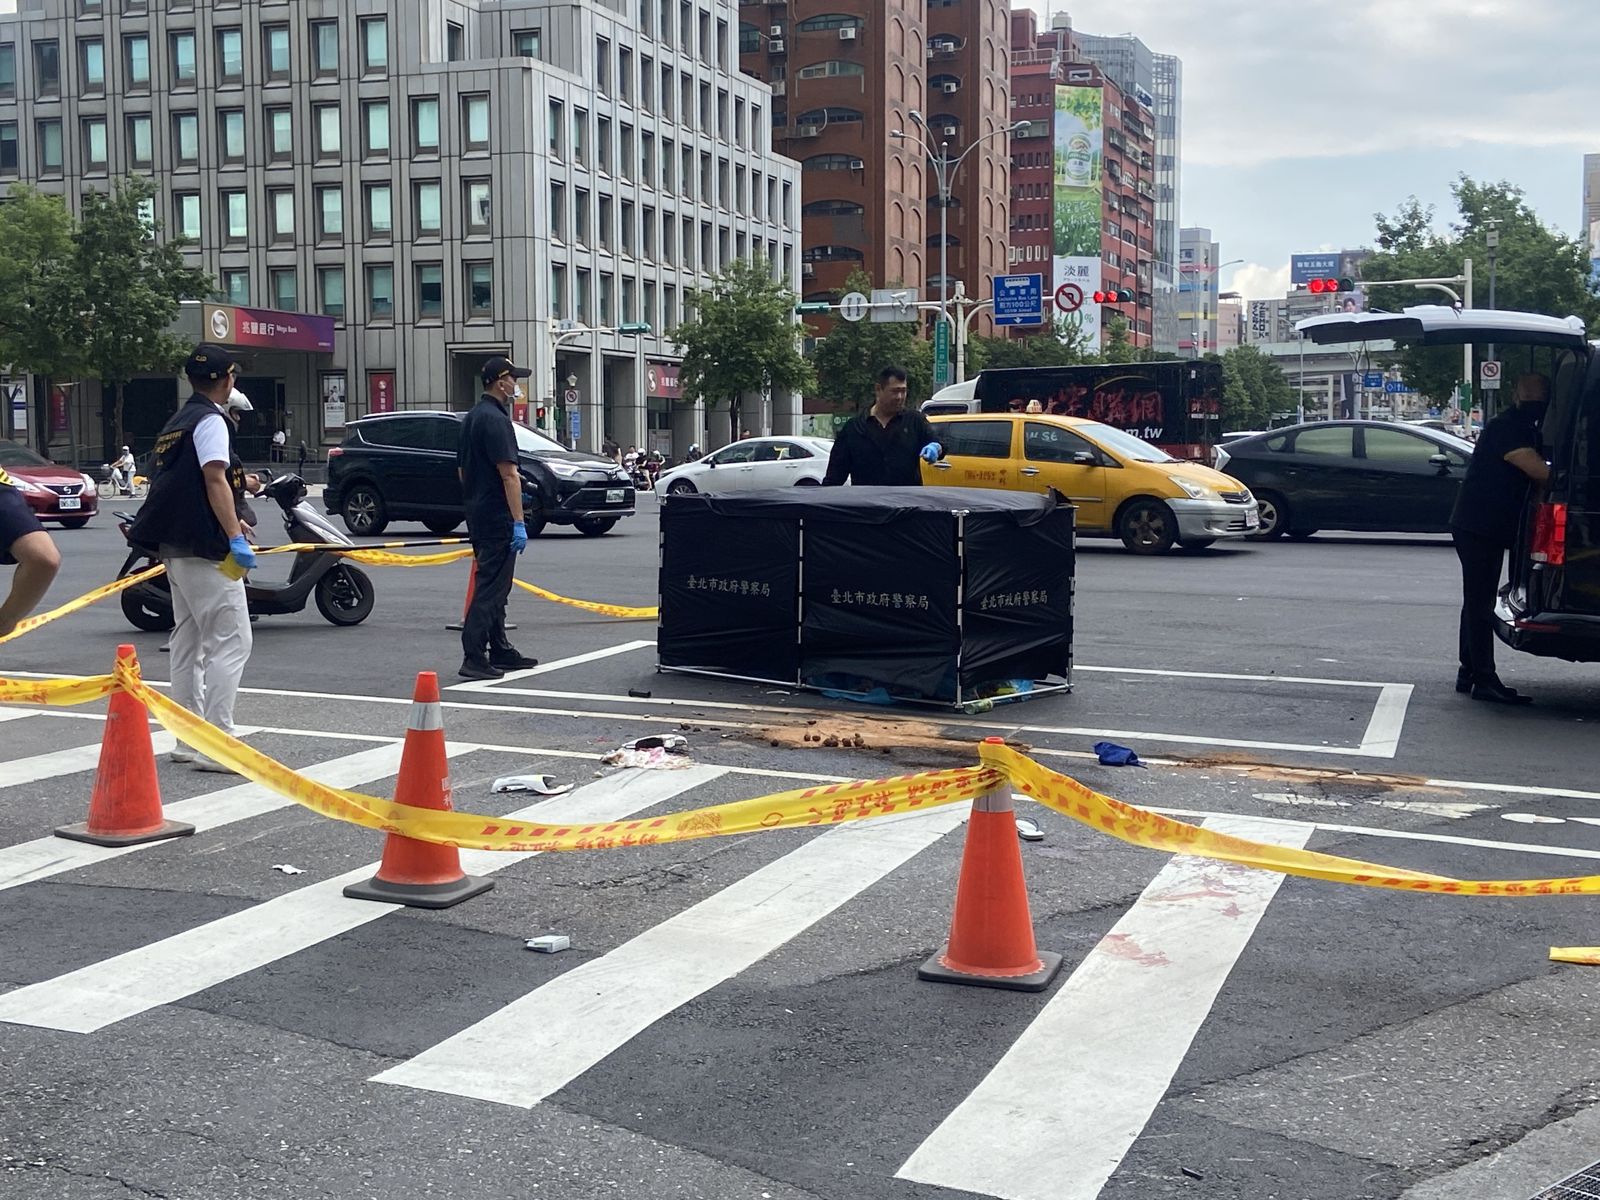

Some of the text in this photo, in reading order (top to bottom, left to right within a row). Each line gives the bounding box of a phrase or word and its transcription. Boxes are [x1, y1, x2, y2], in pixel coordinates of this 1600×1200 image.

[1064, 265, 1089, 277] 淡麗
[242, 321, 275, 336] 兆豐銀行
[687, 574, 771, 597] 臺北市政府警察局
[830, 588, 929, 610] 臺北市政府警察局
[980, 589, 1048, 610] 臺北市政府警察局
